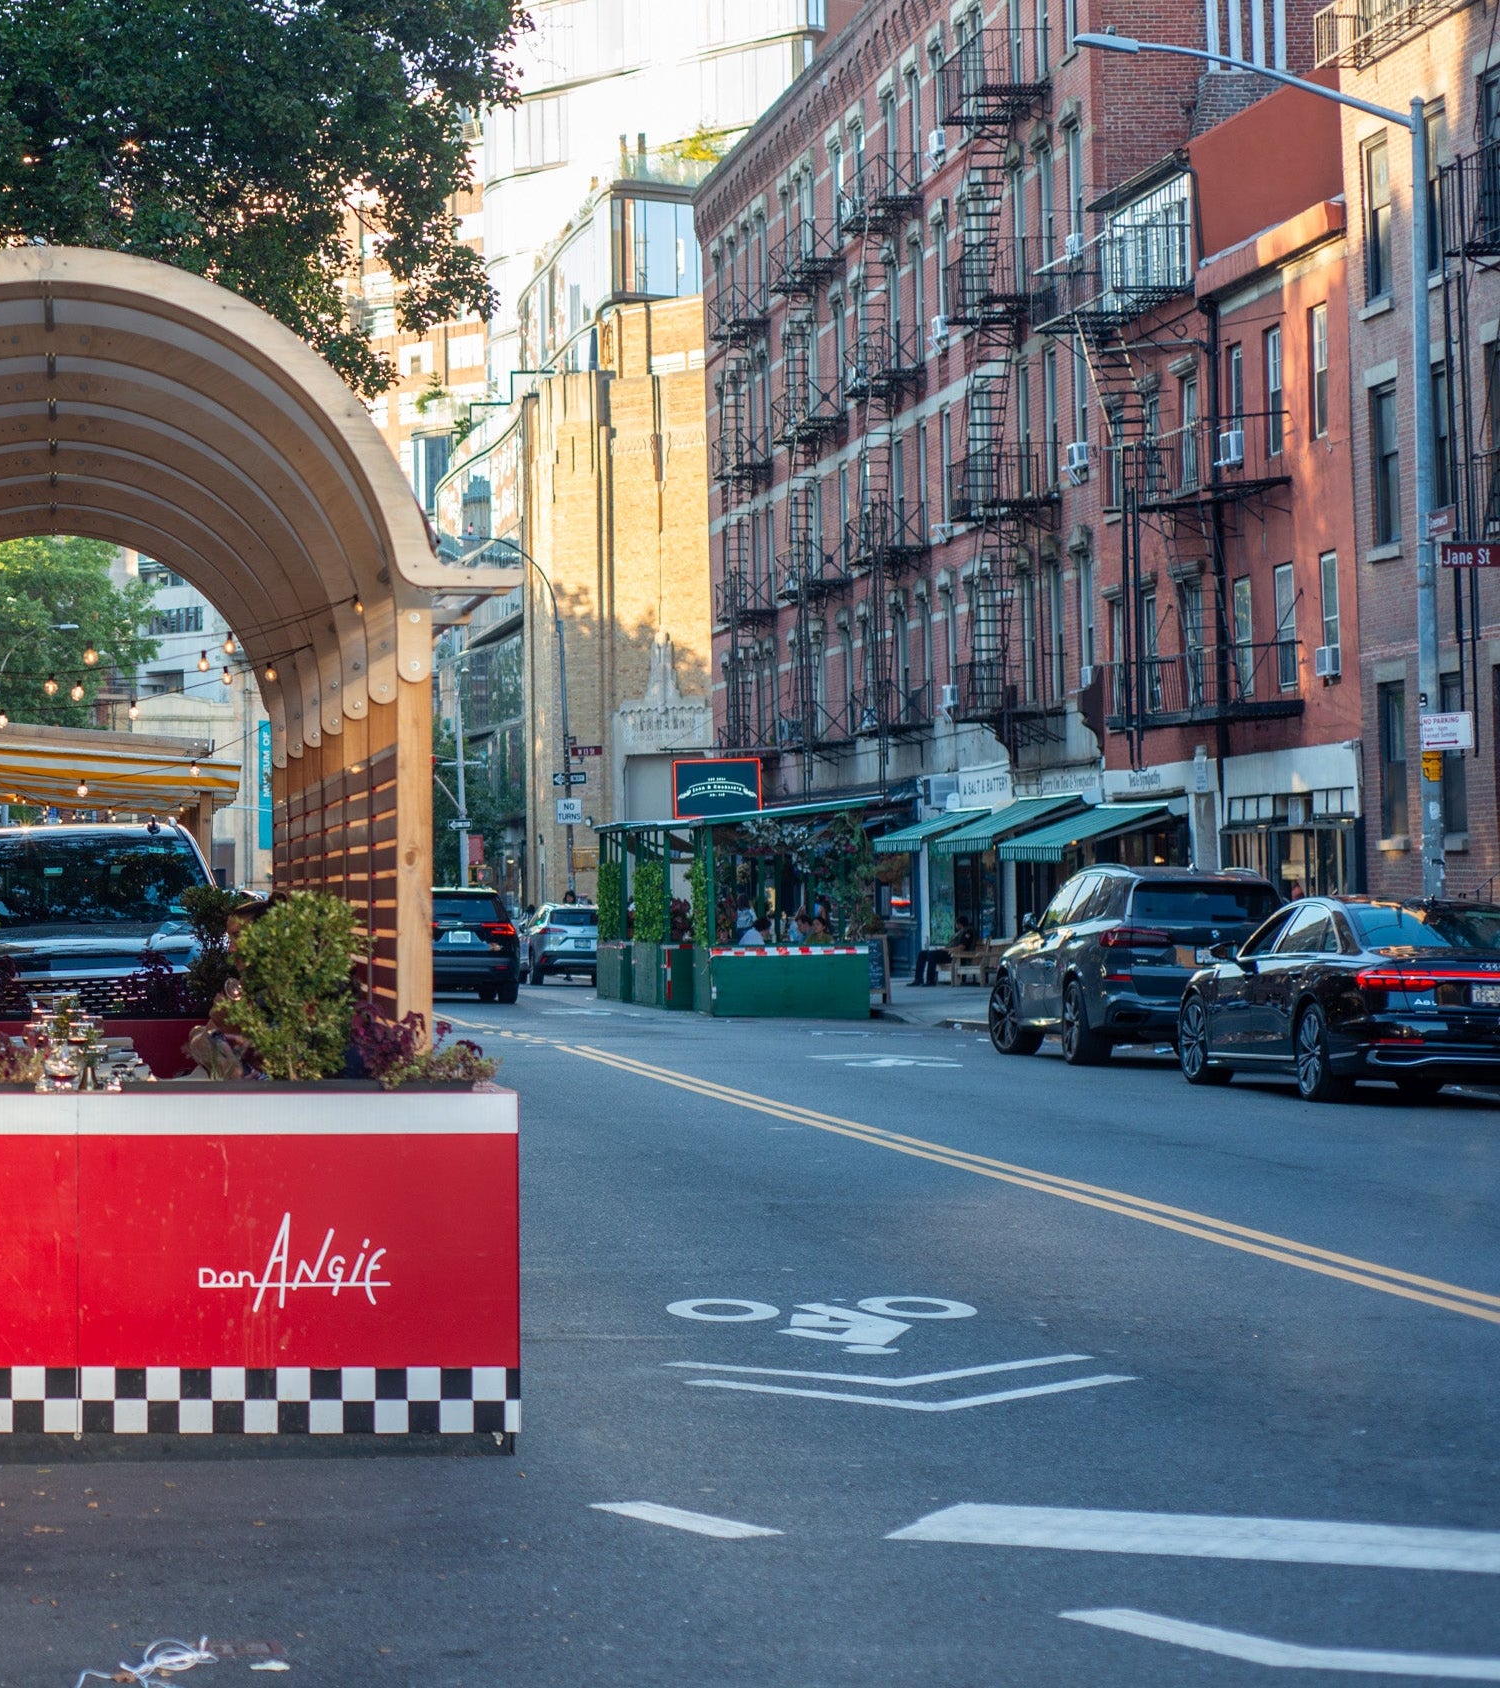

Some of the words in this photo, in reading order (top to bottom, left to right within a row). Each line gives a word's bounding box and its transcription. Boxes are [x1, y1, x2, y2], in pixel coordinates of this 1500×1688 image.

[1443, 548, 1473, 565] Jane
[1477, 547, 1491, 565] St
[1433, 716, 1460, 724] PARKING
[262, 731, 271, 746] OF
[968, 779, 981, 796] SALT
[986, 776, 1008, 793] BATTERY
[564, 802, 575, 811] NO
[558, 812, 580, 821] TURNS
